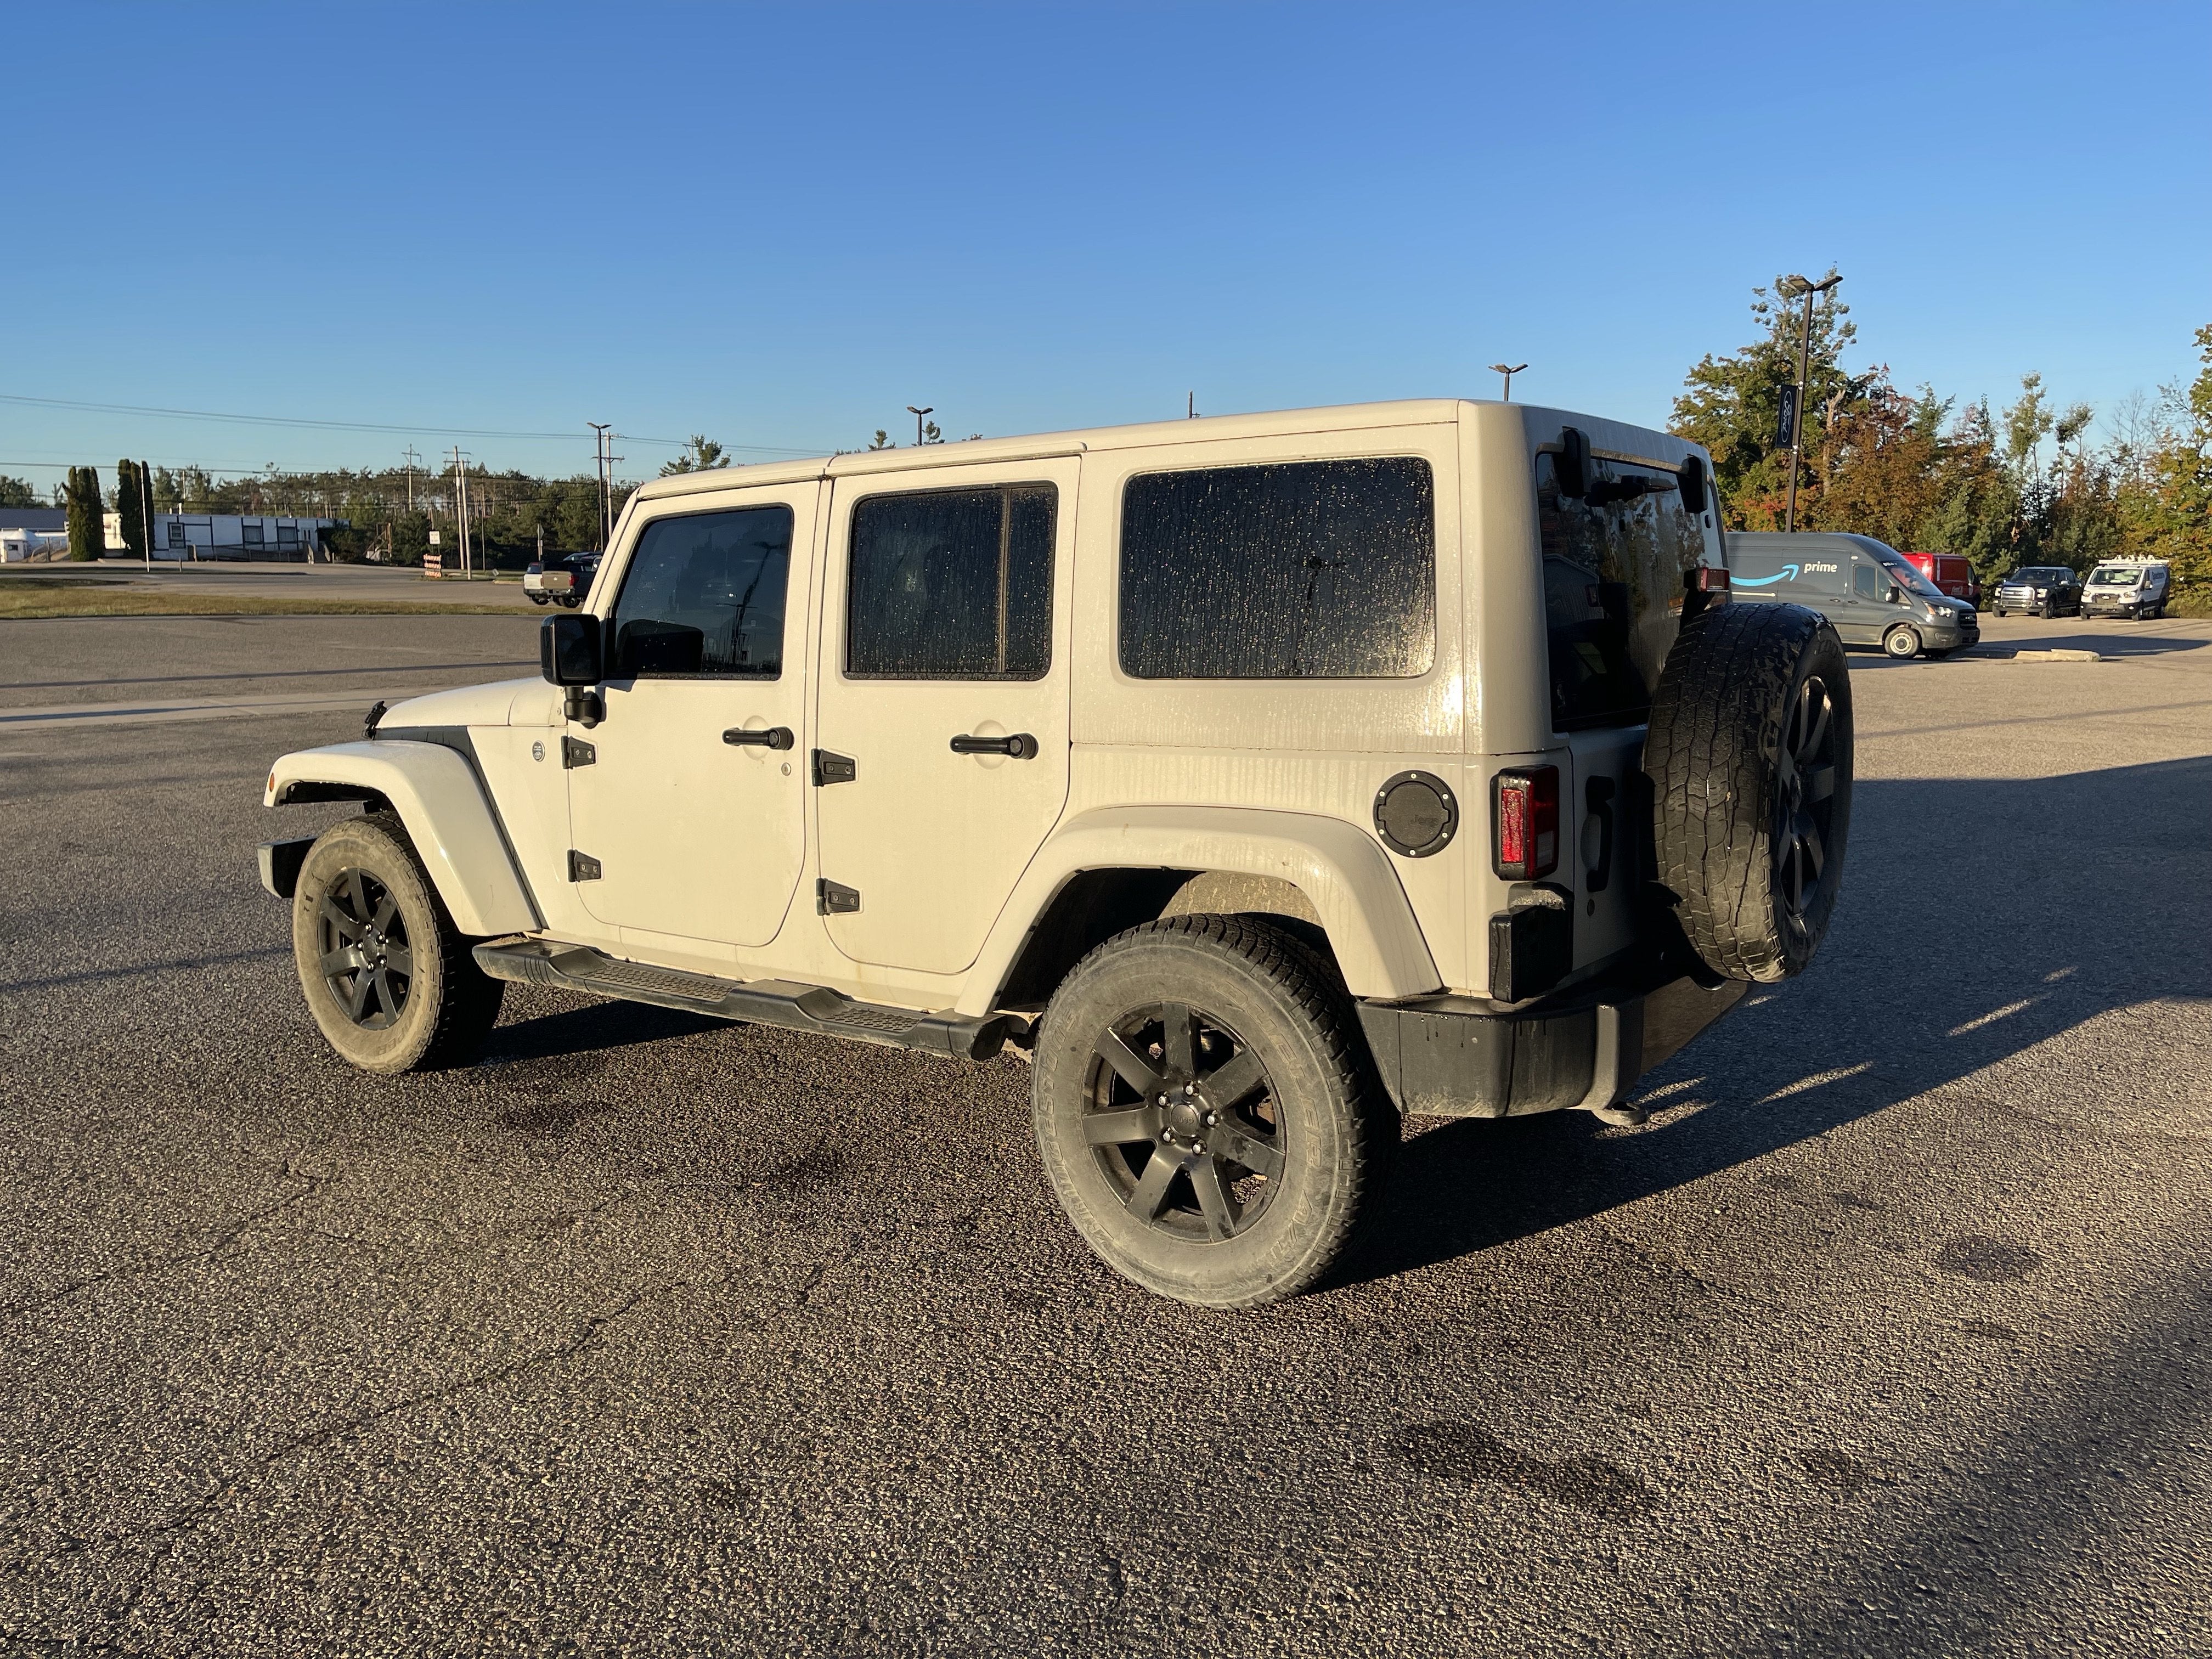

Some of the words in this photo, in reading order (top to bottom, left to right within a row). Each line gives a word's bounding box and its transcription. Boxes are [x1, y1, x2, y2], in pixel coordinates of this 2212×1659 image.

[1804, 561, 1838, 574] prime
[1039, 1007, 1114, 1243] BRIDGESTONE
[1211, 979, 1322, 1169] DUELER
